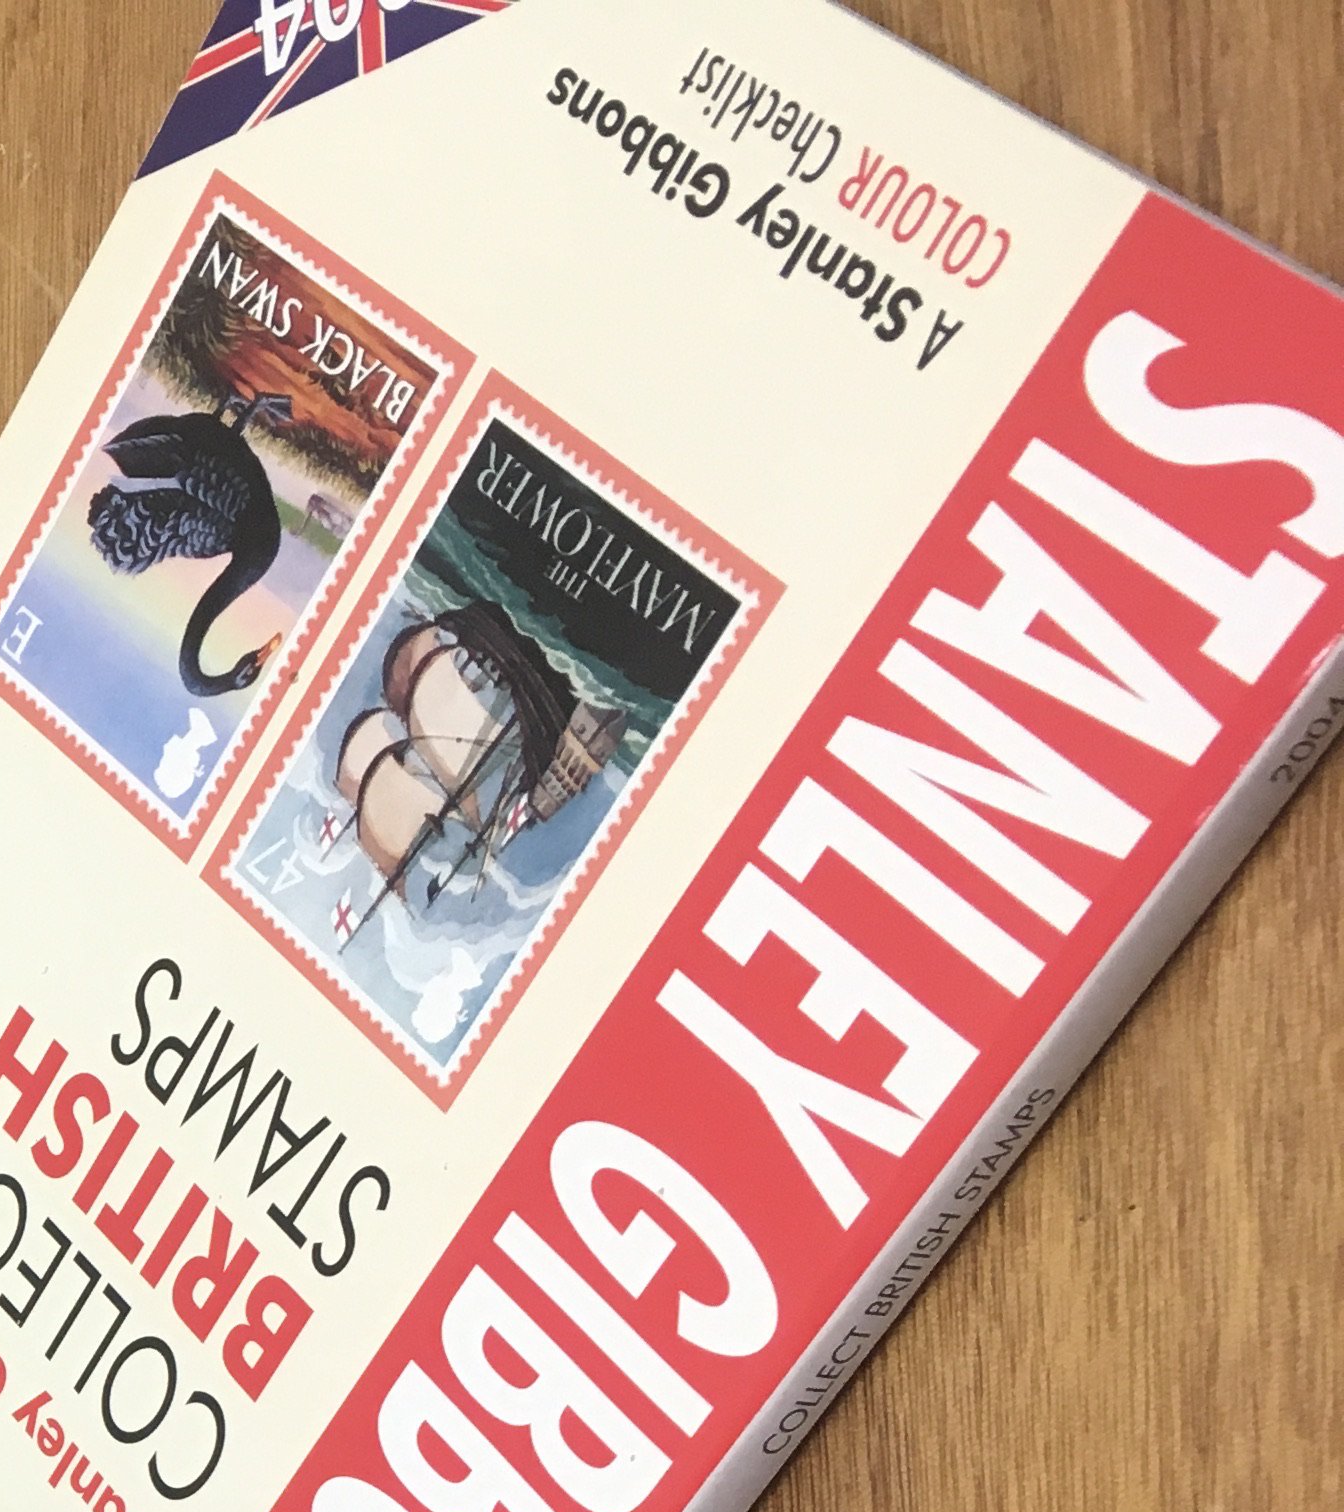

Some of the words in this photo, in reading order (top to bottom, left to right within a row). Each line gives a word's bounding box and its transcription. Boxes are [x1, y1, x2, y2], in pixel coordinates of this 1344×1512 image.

[547, 66, 731, 218] Gibbons
[680, 46, 843, 184] Checklist
[736, 183, 922, 343] Stanley
[837, 145, 1012, 288] COLOUR
[200, 240, 303, 338] SWAN
[916, 309, 964, 370] A
[301, 319, 416, 423] BLACK
[477, 439, 716, 655] MAYFLOWER
[544, 558, 591, 601] THE
[1, 607, 44, 663] E
[655, 309, 1344, 1231] STANLEY
[112, 958, 391, 1278] STAMPS
[762, 1325, 872, 1456] COLLECT
[866, 1211, 961, 1318] BRITISH
[955, 1085, 1057, 1205] STAMPS
